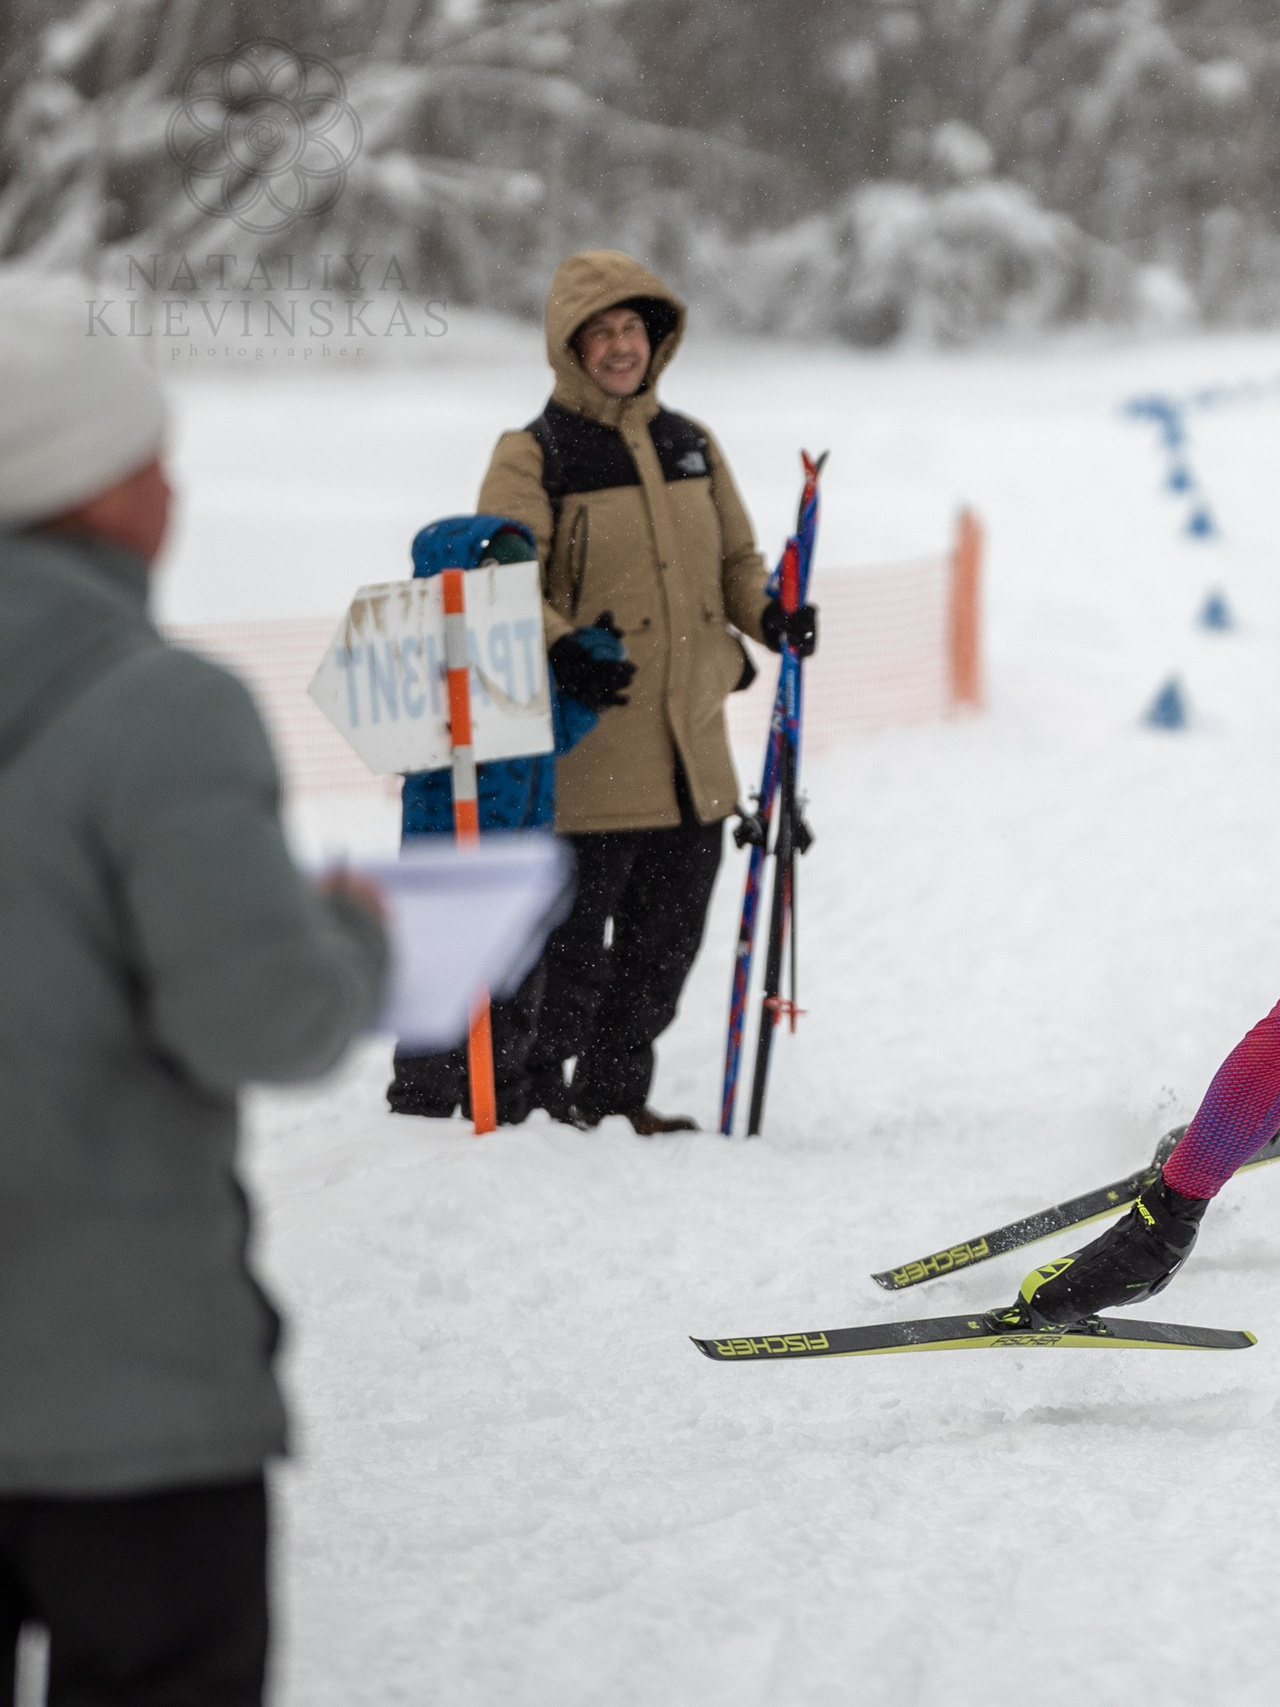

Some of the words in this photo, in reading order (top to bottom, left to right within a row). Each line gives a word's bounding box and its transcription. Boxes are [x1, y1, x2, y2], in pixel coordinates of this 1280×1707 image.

[889, 1237, 989, 1284] FISCHER
[713, 1332, 829, 1356] FISCHER
[990, 1335, 1062, 1346] FISCHER
